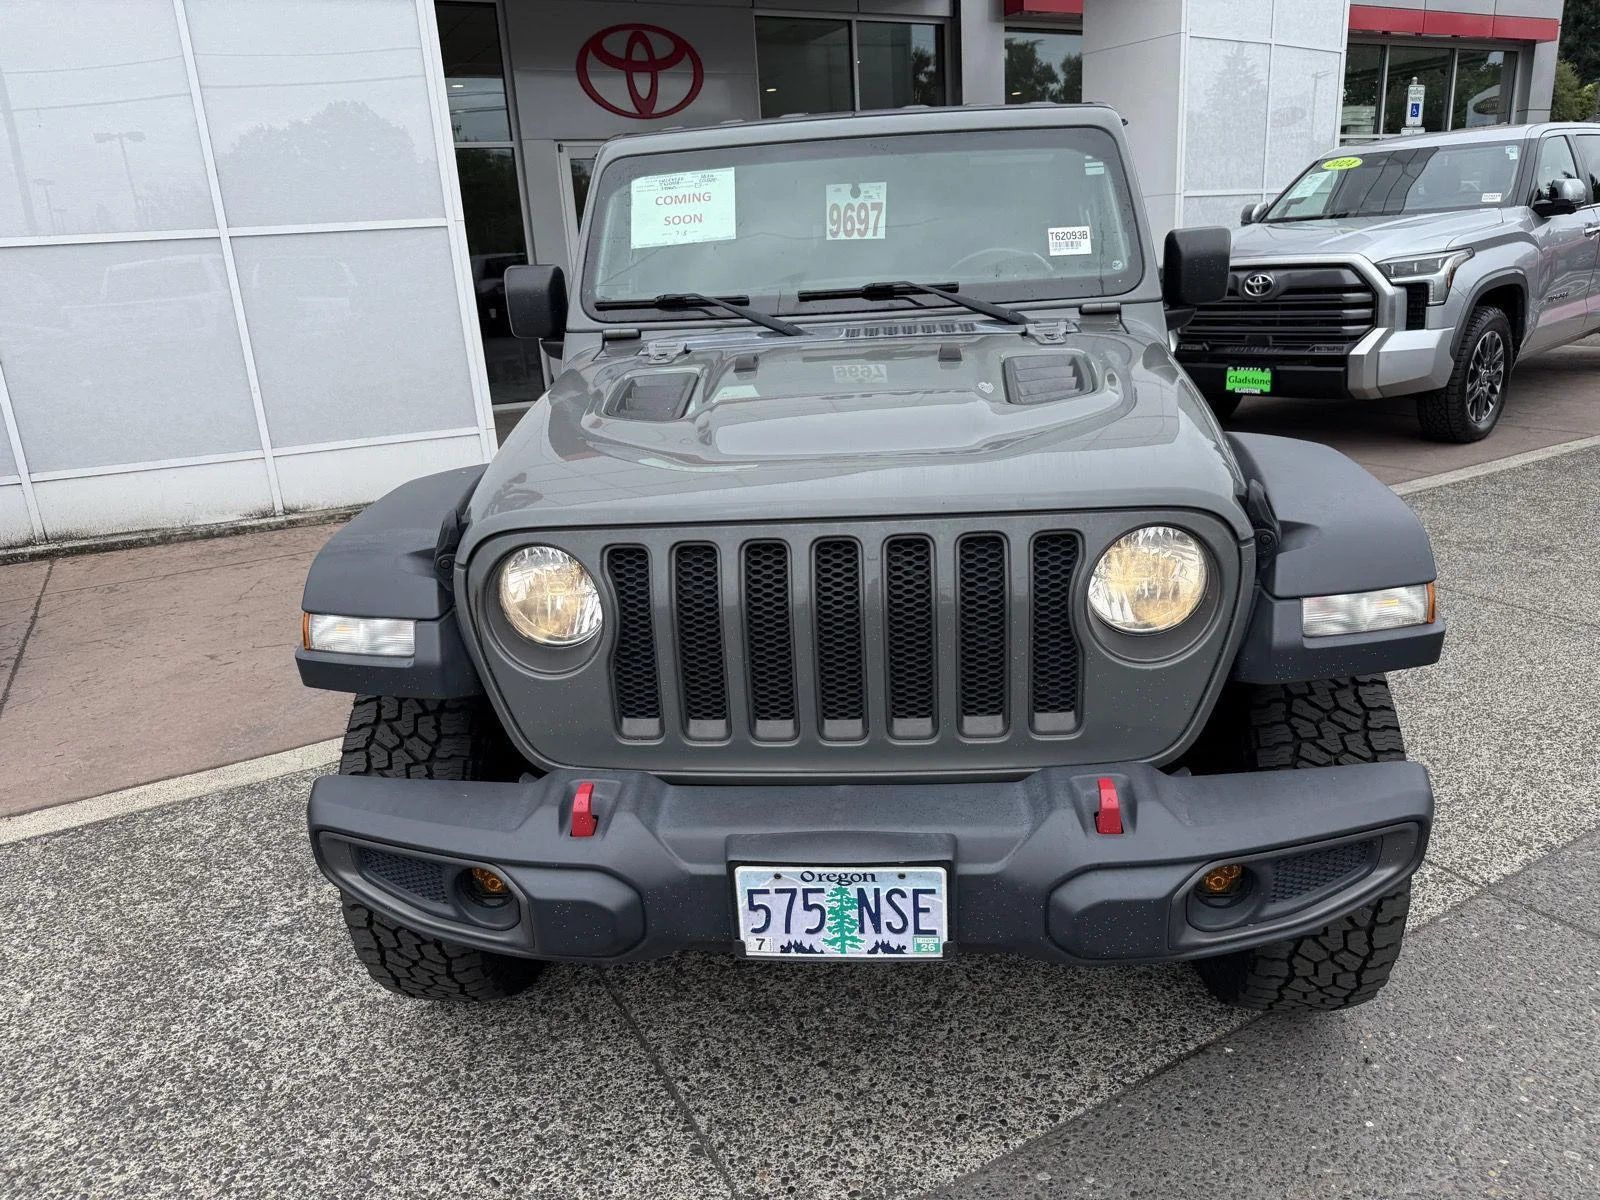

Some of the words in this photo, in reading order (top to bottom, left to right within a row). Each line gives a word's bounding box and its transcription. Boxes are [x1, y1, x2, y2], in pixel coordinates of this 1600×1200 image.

[655, 191, 712, 206] COMING
[664, 213, 703, 226] SOON
[829, 202, 883, 238] 9697
[1050, 230, 1088, 241] T62093B
[1228, 375, 1270, 386] Gladstone
[800, 871, 878, 886] Oregon
[747, 888, 826, 934] 575
[857, 888, 938, 935] NSE
[755, 938, 765, 951] 7
[921, 943, 936, 952] 26
